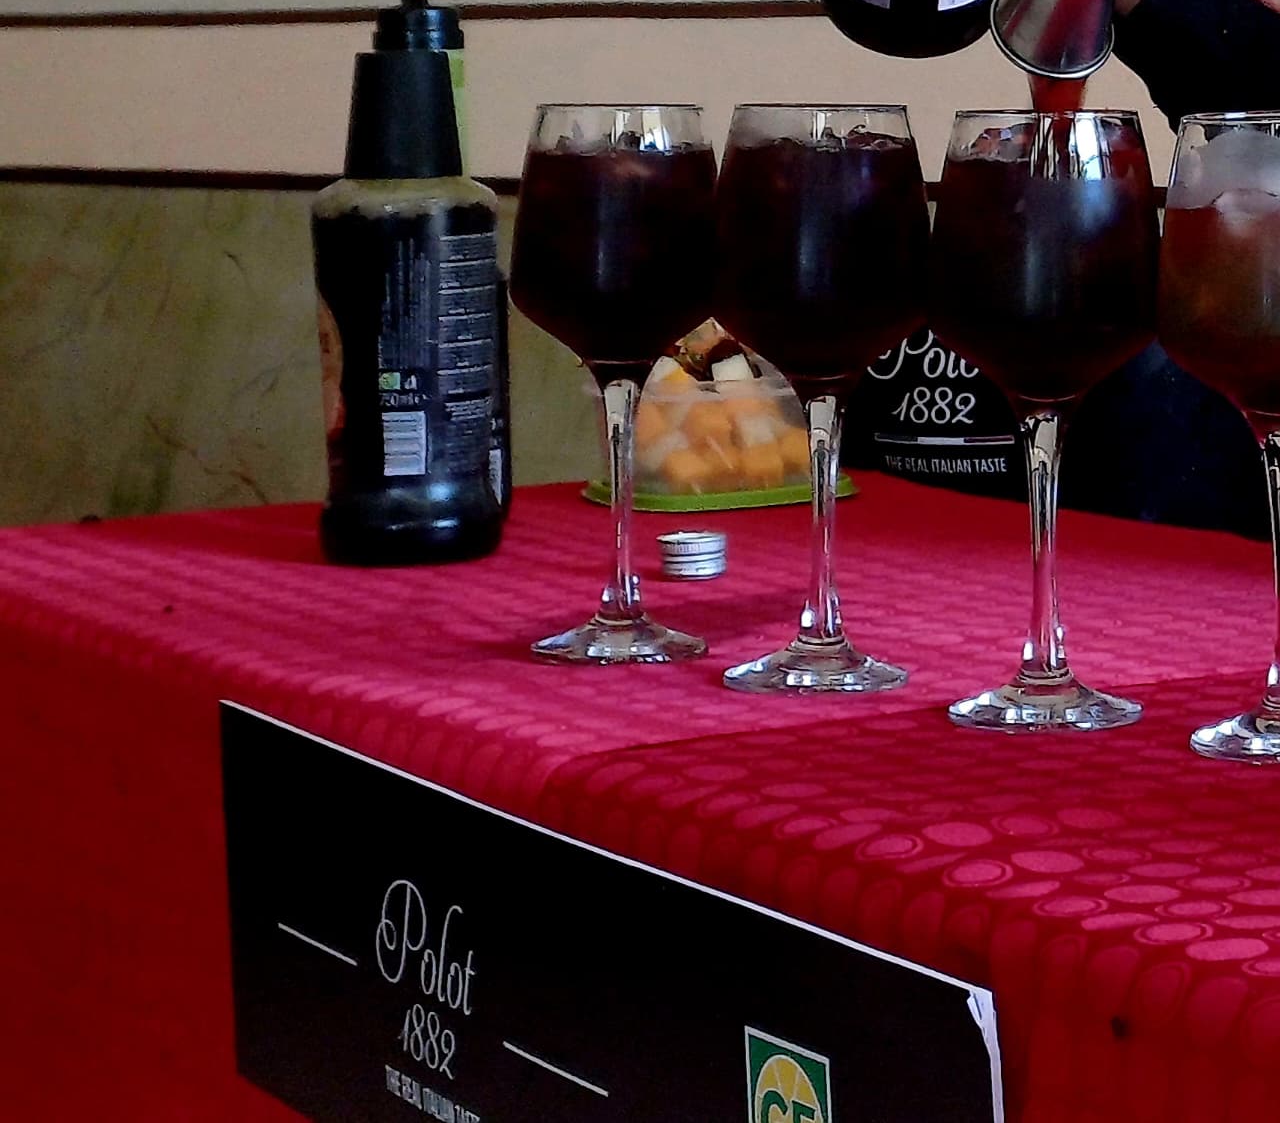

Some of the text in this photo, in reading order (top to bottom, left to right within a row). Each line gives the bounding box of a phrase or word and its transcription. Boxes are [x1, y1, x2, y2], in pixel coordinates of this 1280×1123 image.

[892, 387, 976, 425] 1882
[884, 455, 1008, 474] THE REAL ITALIAN TASTE
[376, 879, 476, 1016] Polot
[398, 1004, 455, 1080] 1882
